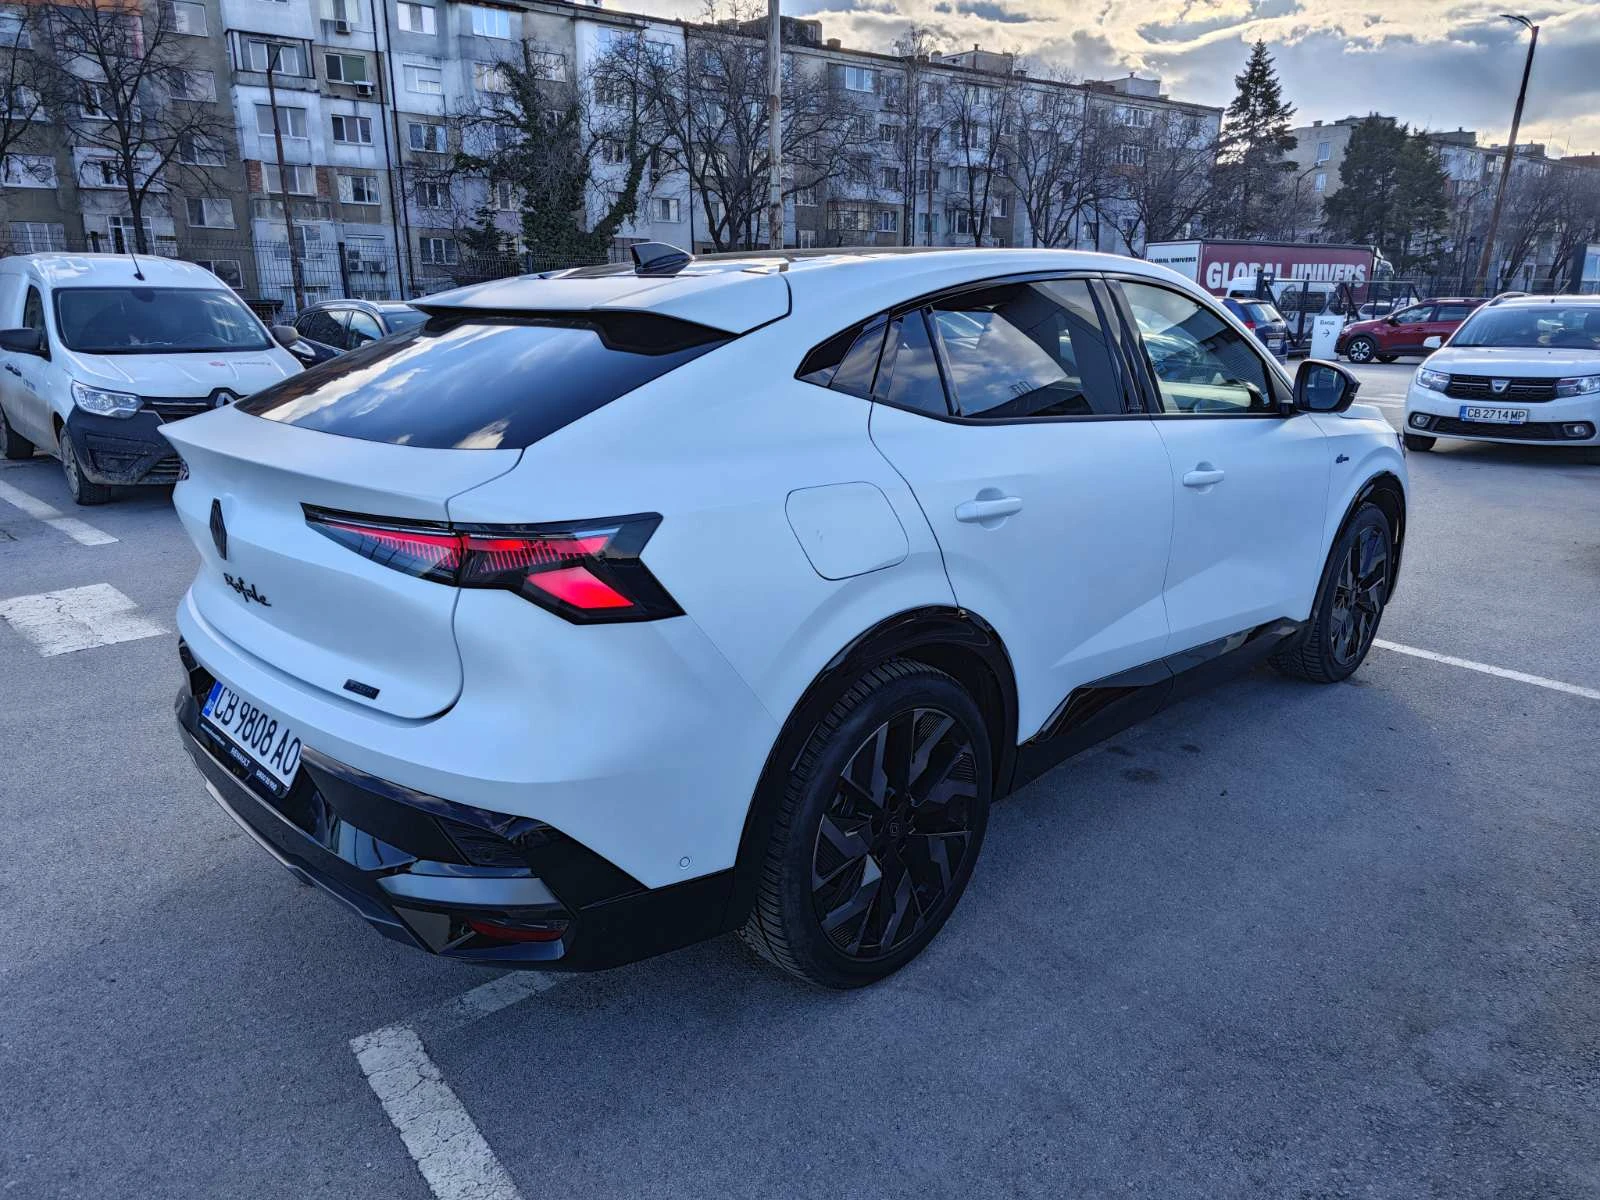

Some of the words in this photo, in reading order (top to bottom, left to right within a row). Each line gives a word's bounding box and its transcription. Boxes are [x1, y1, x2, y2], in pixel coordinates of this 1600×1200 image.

[1467, 408, 1480, 418] CB
[1482, 409, 1509, 420] 2714
[1510, 410, 1526, 421] MP
[214, 687, 239, 726] CB
[234, 701, 278, 757] 9808
[270, 728, 302, 776] AO
